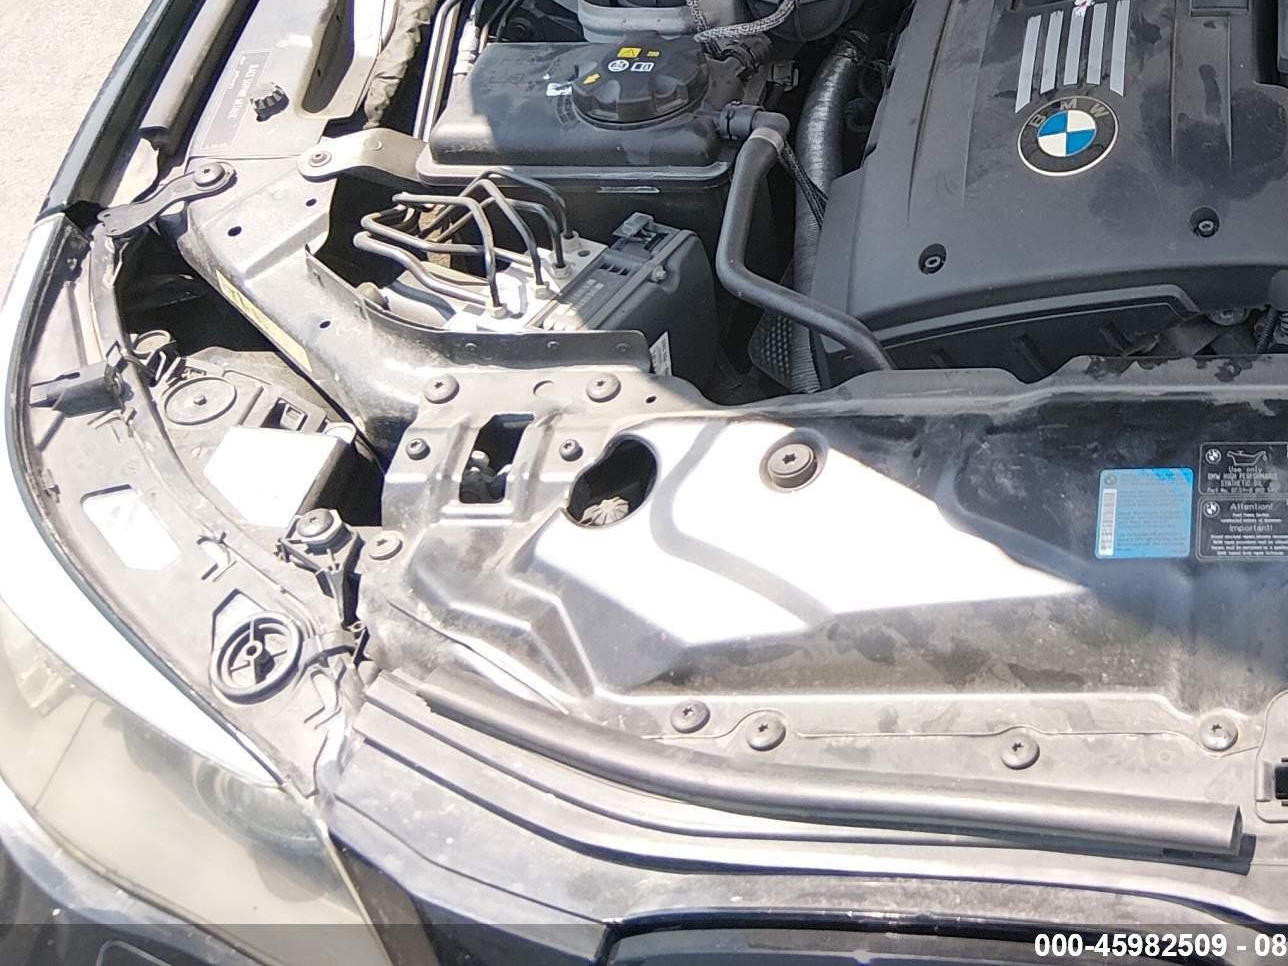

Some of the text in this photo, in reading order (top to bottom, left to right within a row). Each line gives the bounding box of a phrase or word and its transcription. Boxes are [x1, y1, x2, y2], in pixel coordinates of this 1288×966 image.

[1029, 97, 1110, 128] BMW
[1228, 465, 1263, 474] Use only
[1230, 502, 1273, 511] Attention!
[1229, 524, 1273, 532] Important!
